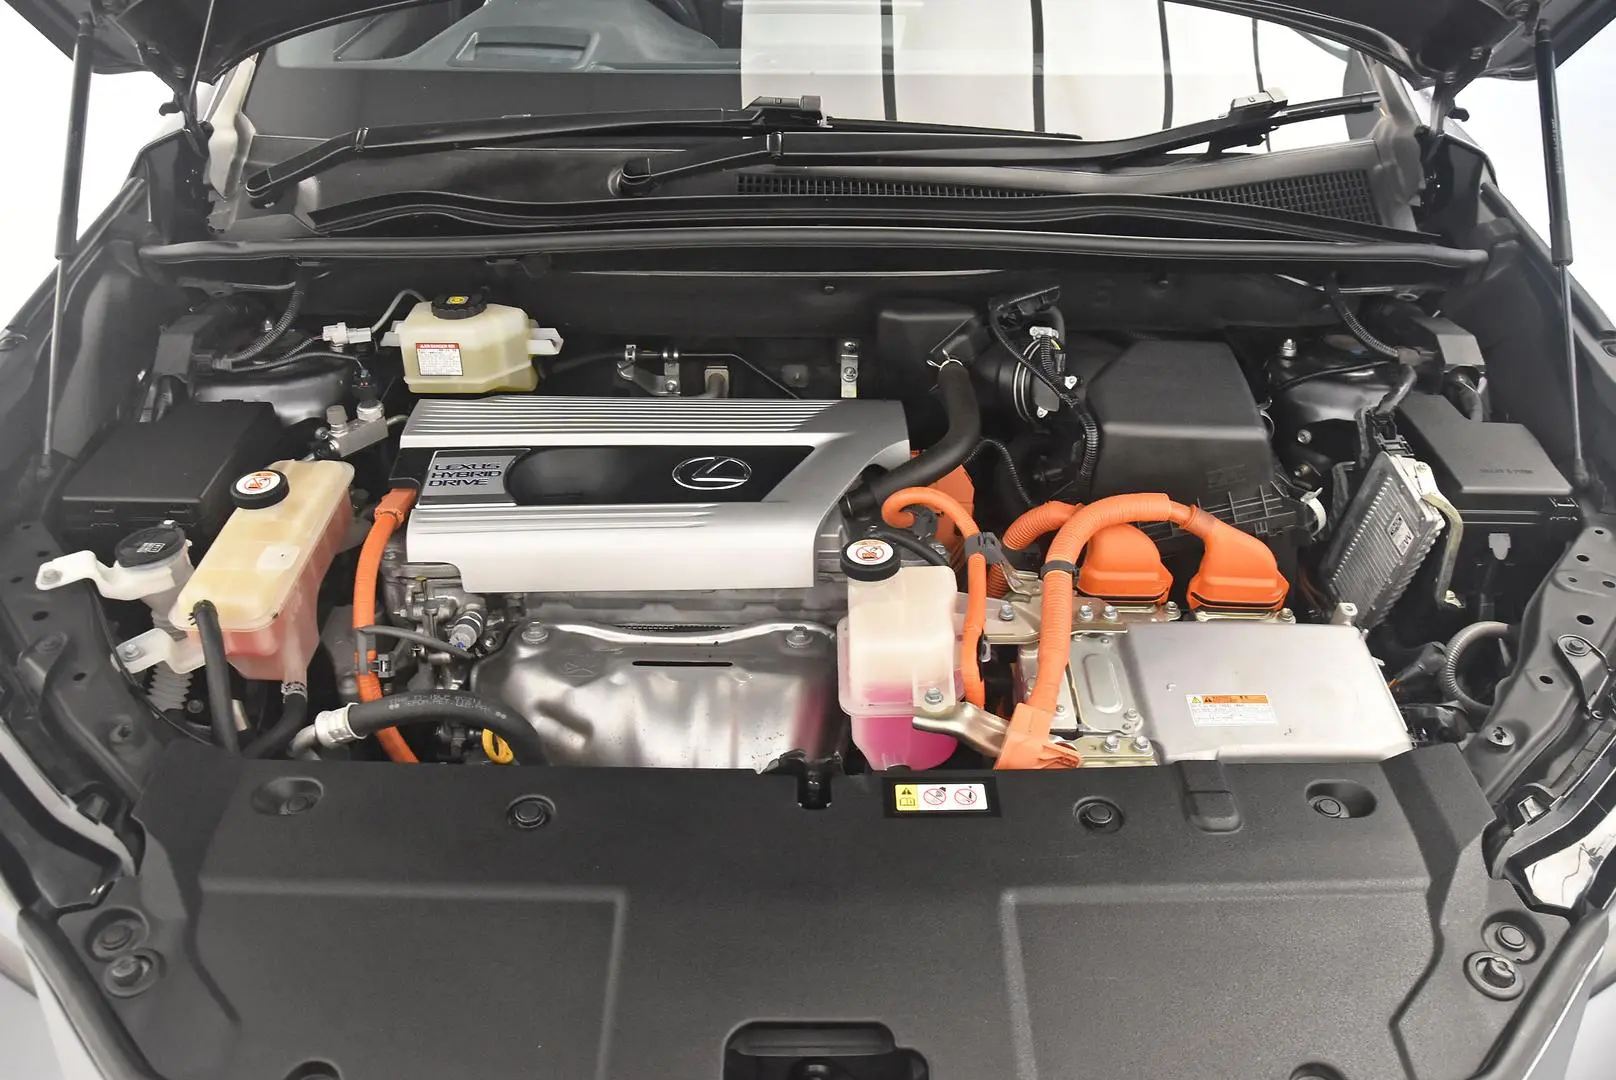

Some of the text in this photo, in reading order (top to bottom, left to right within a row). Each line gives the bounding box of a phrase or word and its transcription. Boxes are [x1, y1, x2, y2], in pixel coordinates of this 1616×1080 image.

[435, 462, 500, 471] LEXUS
[431, 470, 502, 479] HYBRID
[428, 478, 489, 487] DRIVE
